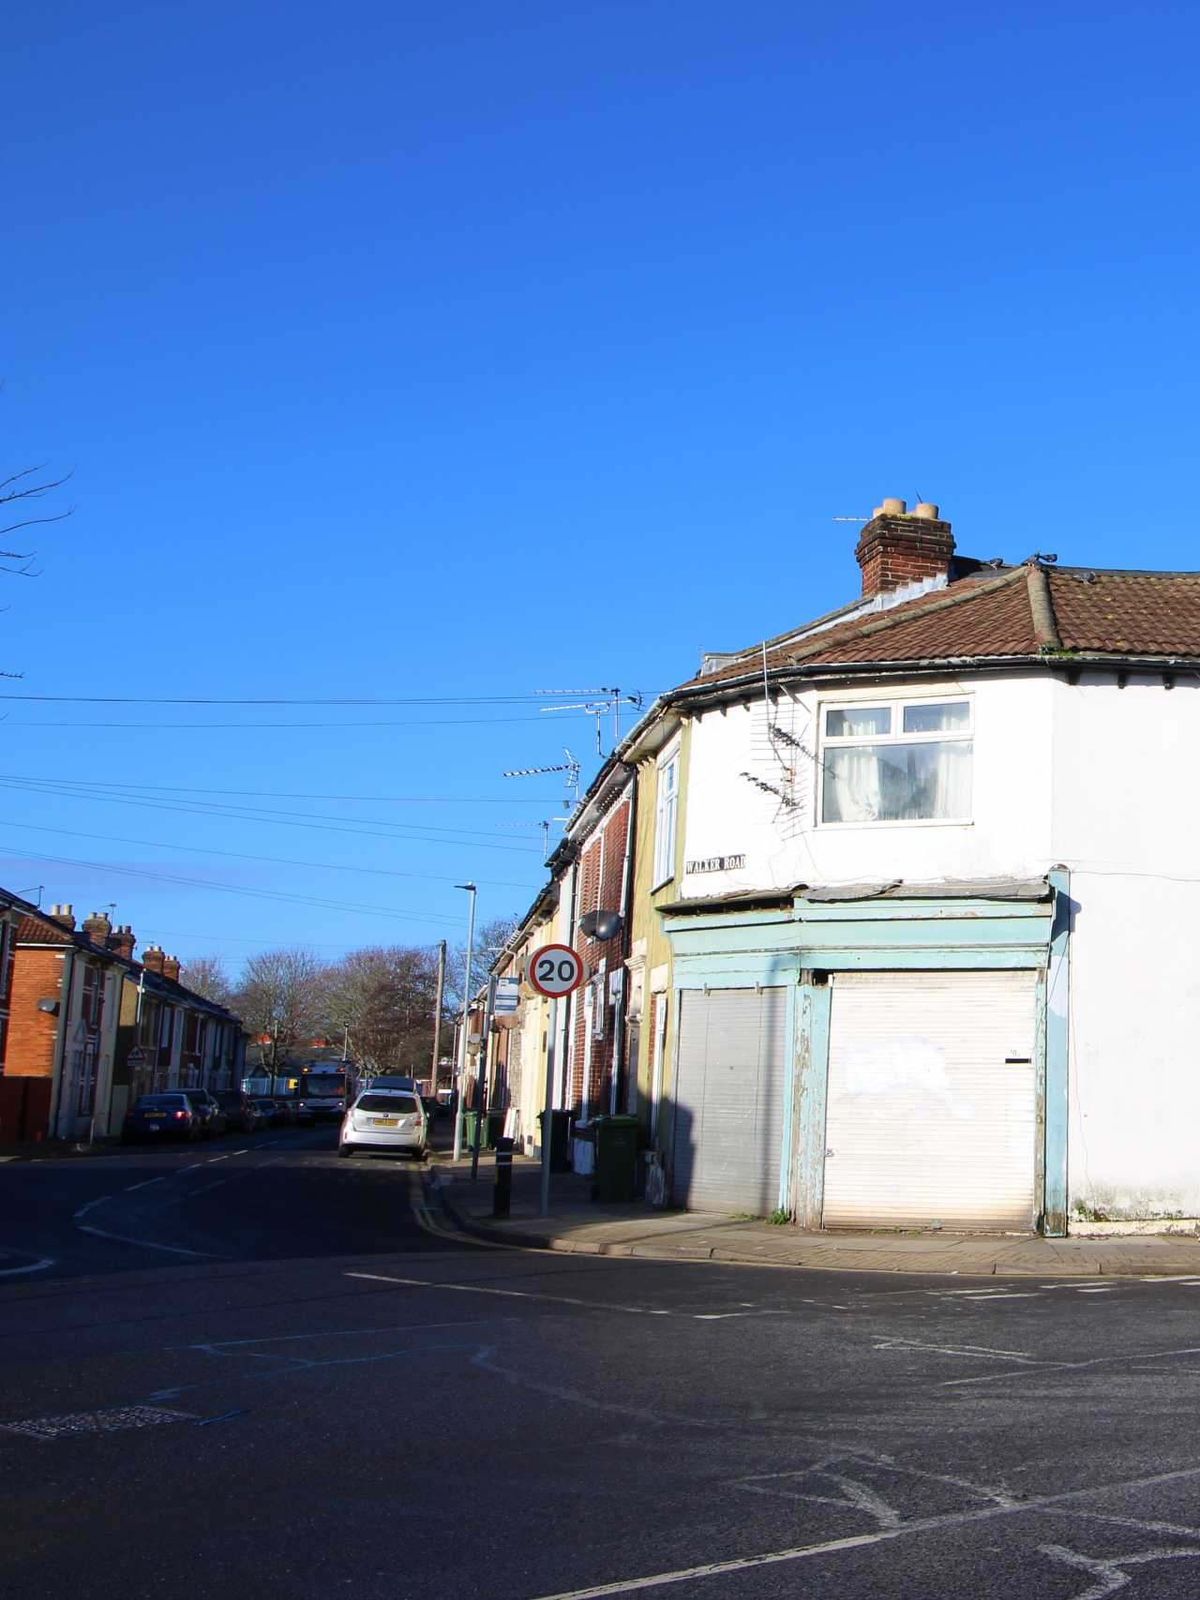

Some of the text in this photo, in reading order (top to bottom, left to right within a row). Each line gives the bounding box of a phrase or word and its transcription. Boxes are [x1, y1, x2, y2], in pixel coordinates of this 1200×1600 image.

[687, 855, 746, 873] WALKER ROAD
[538, 959, 574, 982] 20
